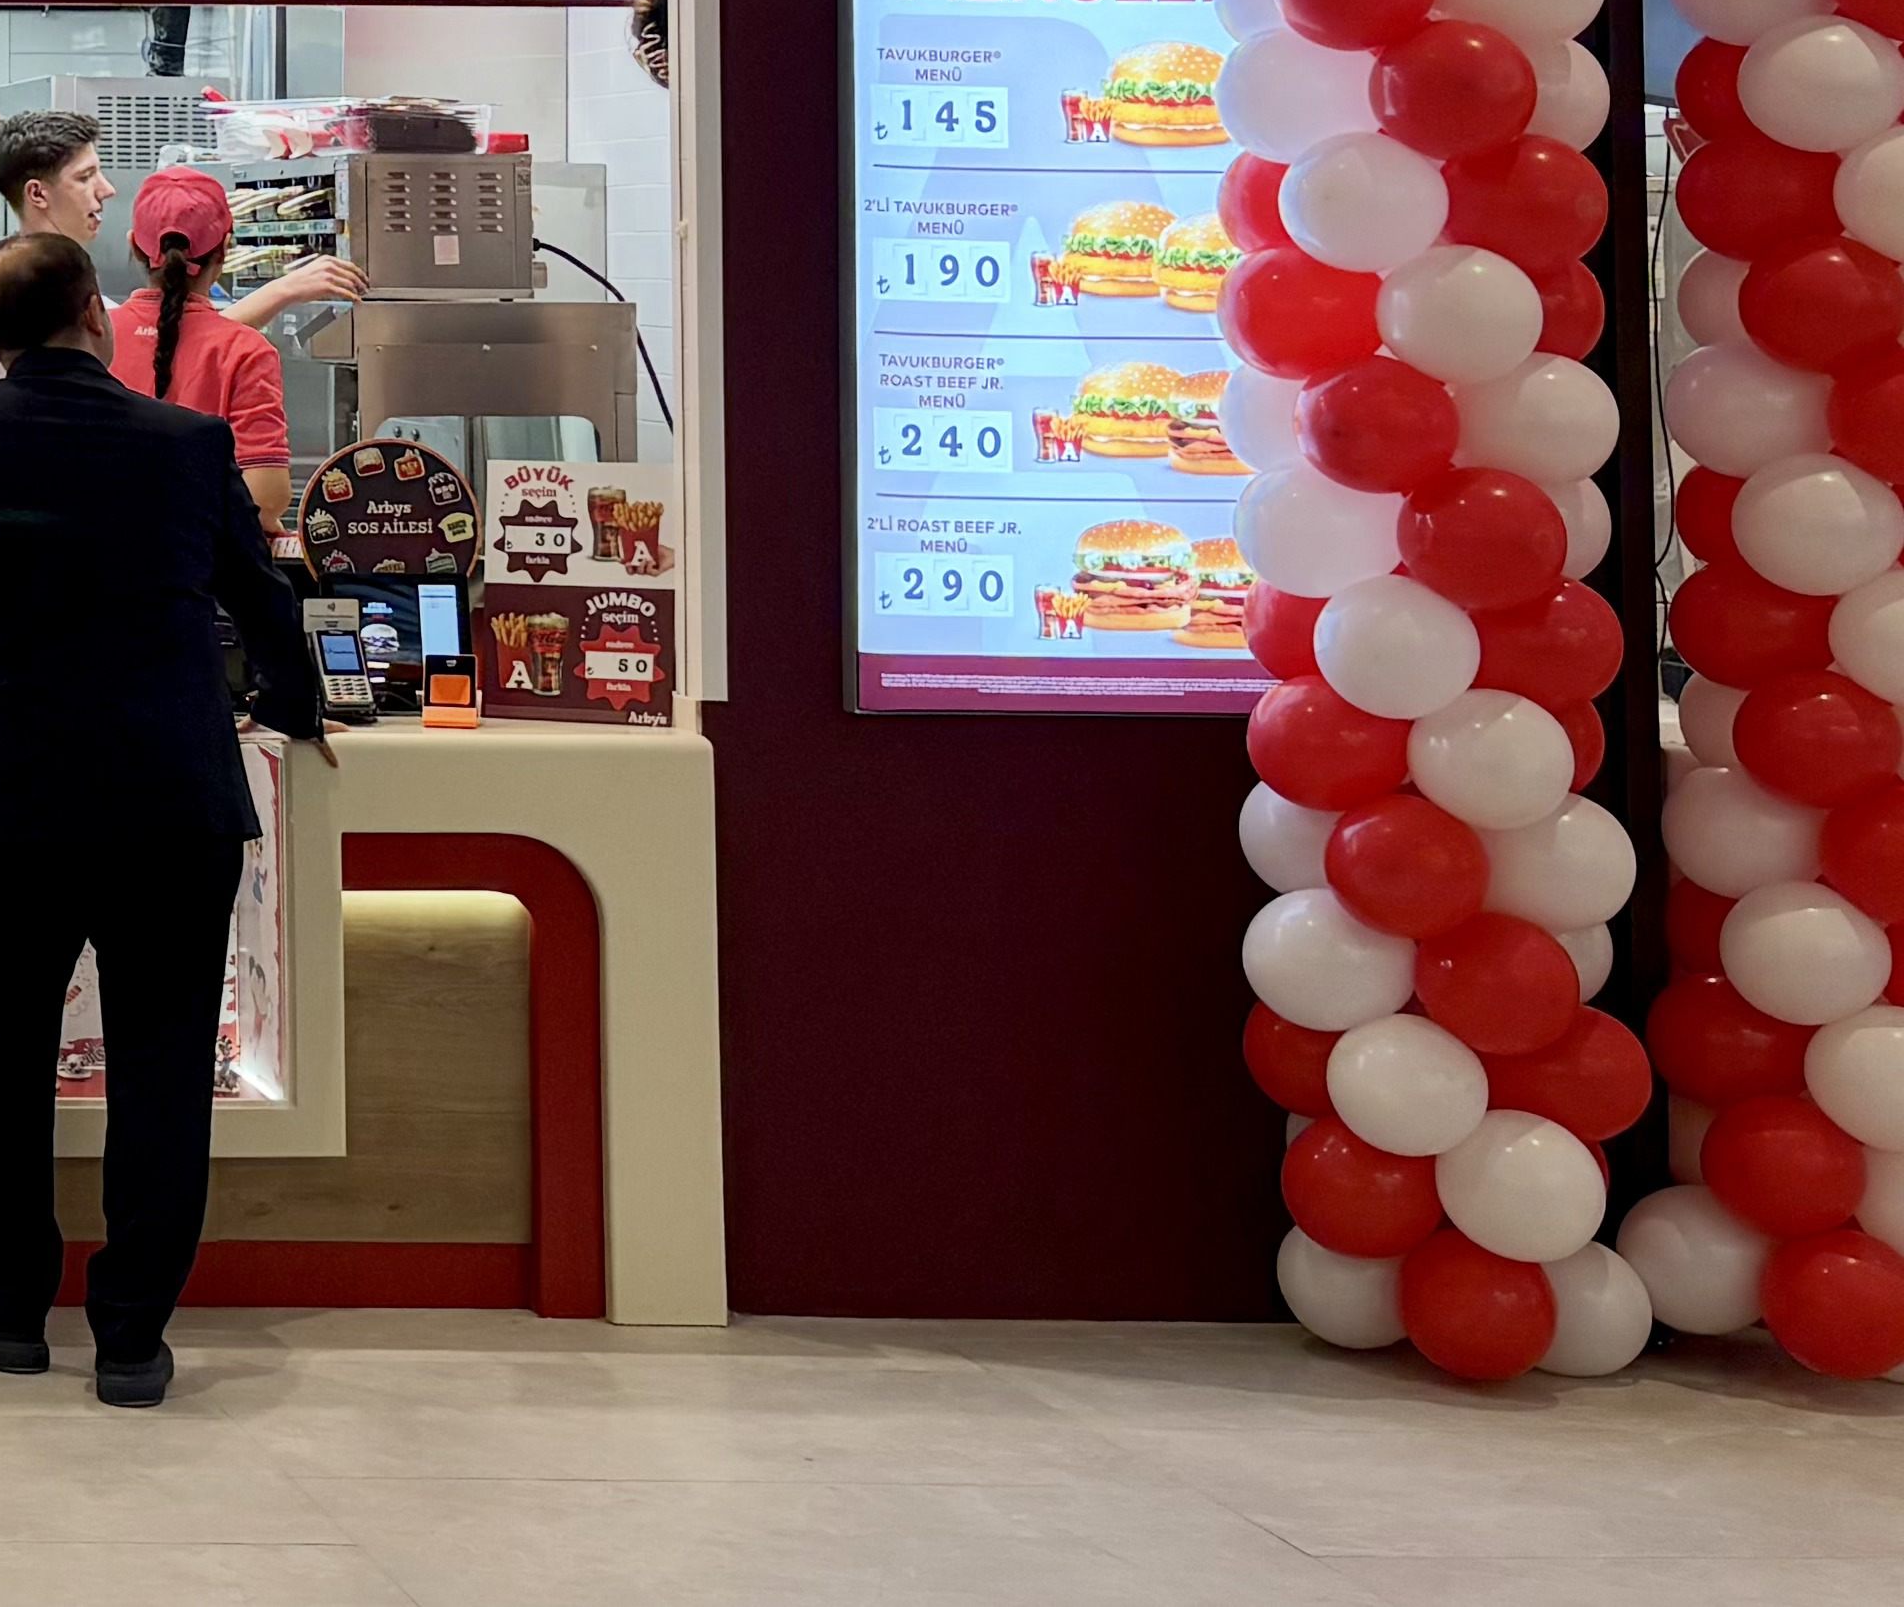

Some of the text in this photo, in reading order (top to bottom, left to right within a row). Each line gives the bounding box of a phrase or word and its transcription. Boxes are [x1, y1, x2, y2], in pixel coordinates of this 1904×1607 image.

[914, 67, 962, 81] MENÜ
[917, 220, 964, 235] MENÜ
[879, 373, 1004, 389] ROAST BEEF JR.
[918, 393, 966, 408] MENÜ
[504, 466, 574, 492] BÜYÜK
[522, 487, 556, 499] seçim
[348, 518, 433, 534] SOS AİLESİ
[897, 519, 950, 533] ROAST
[954, 519, 995, 534] BEEF
[998, 520, 1021, 534] JR.
[920, 538, 968, 553] MENÜ
[586, 592, 656, 617] JUMBO
[602, 611, 639, 625] seçim
[628, 711, 667, 726] Arby's
